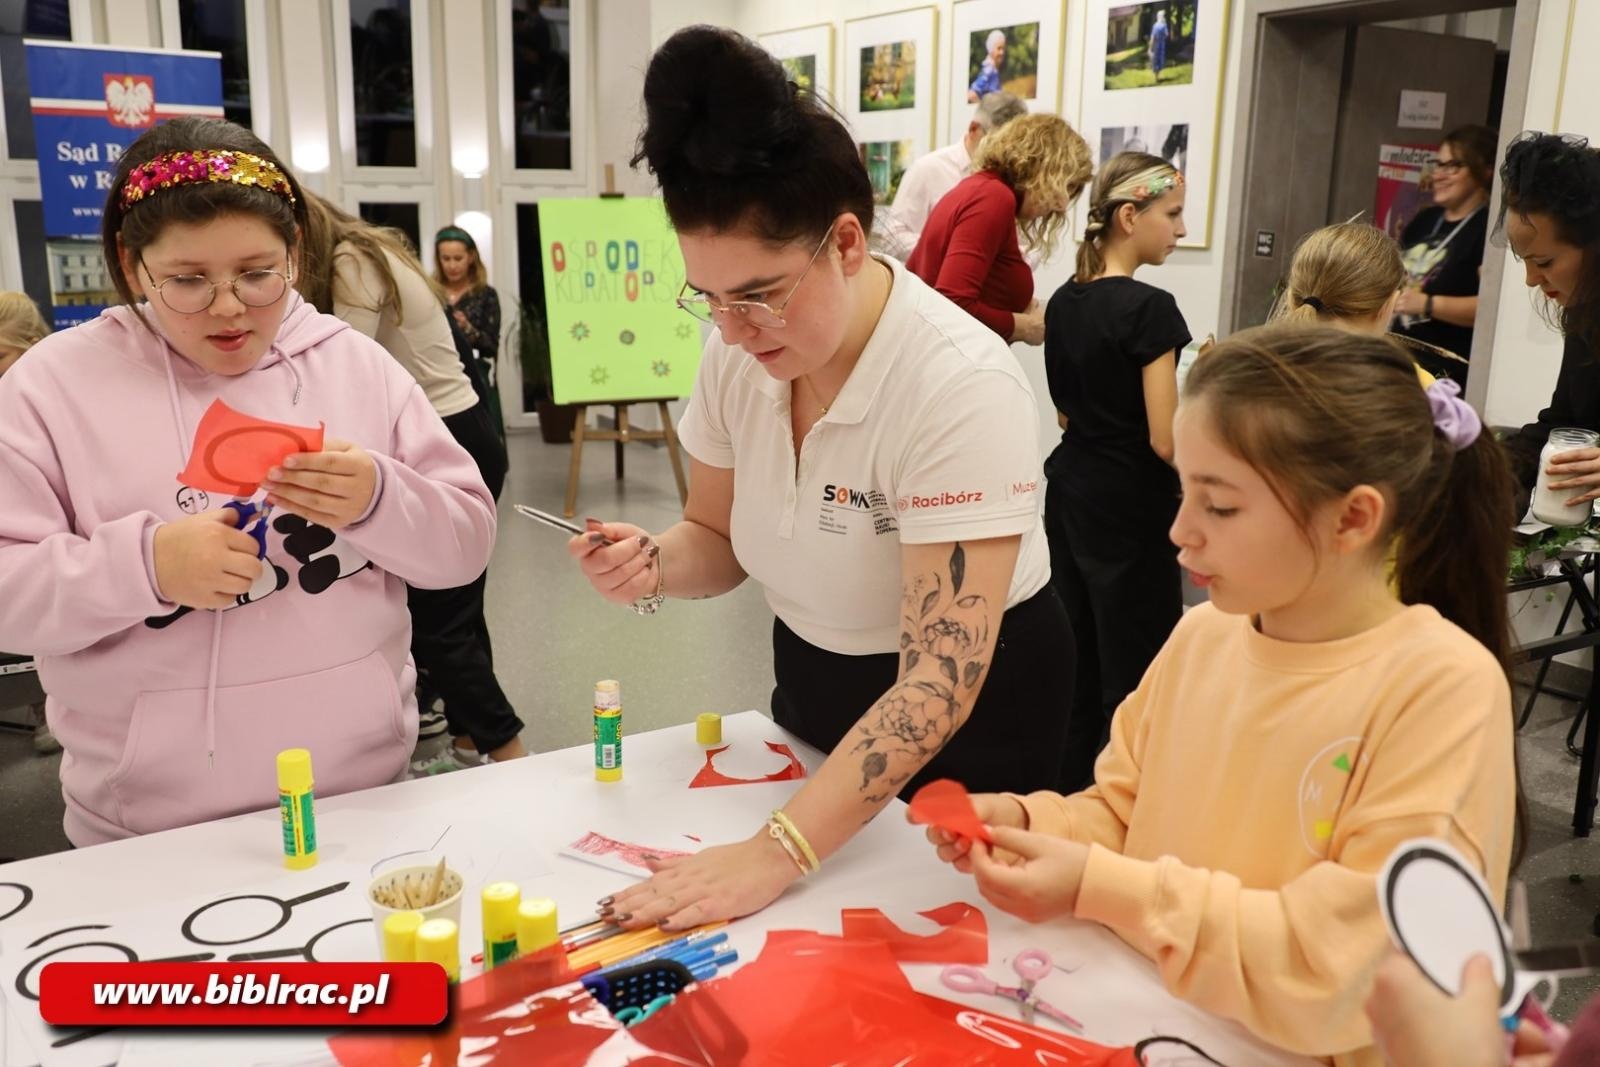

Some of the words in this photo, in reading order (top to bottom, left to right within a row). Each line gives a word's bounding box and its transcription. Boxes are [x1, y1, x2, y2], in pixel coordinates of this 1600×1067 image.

[57, 141, 99, 165] Sąd
[69, 175, 88, 189] w
[73, 208, 103, 216] www.
[1259, 234, 1273, 245] WC
[554, 270, 684, 303] KURATORS
[823, 484, 870, 509] SOWA
[1012, 481, 1038, 496] Muze
[911, 490, 984, 509] Racibórz
